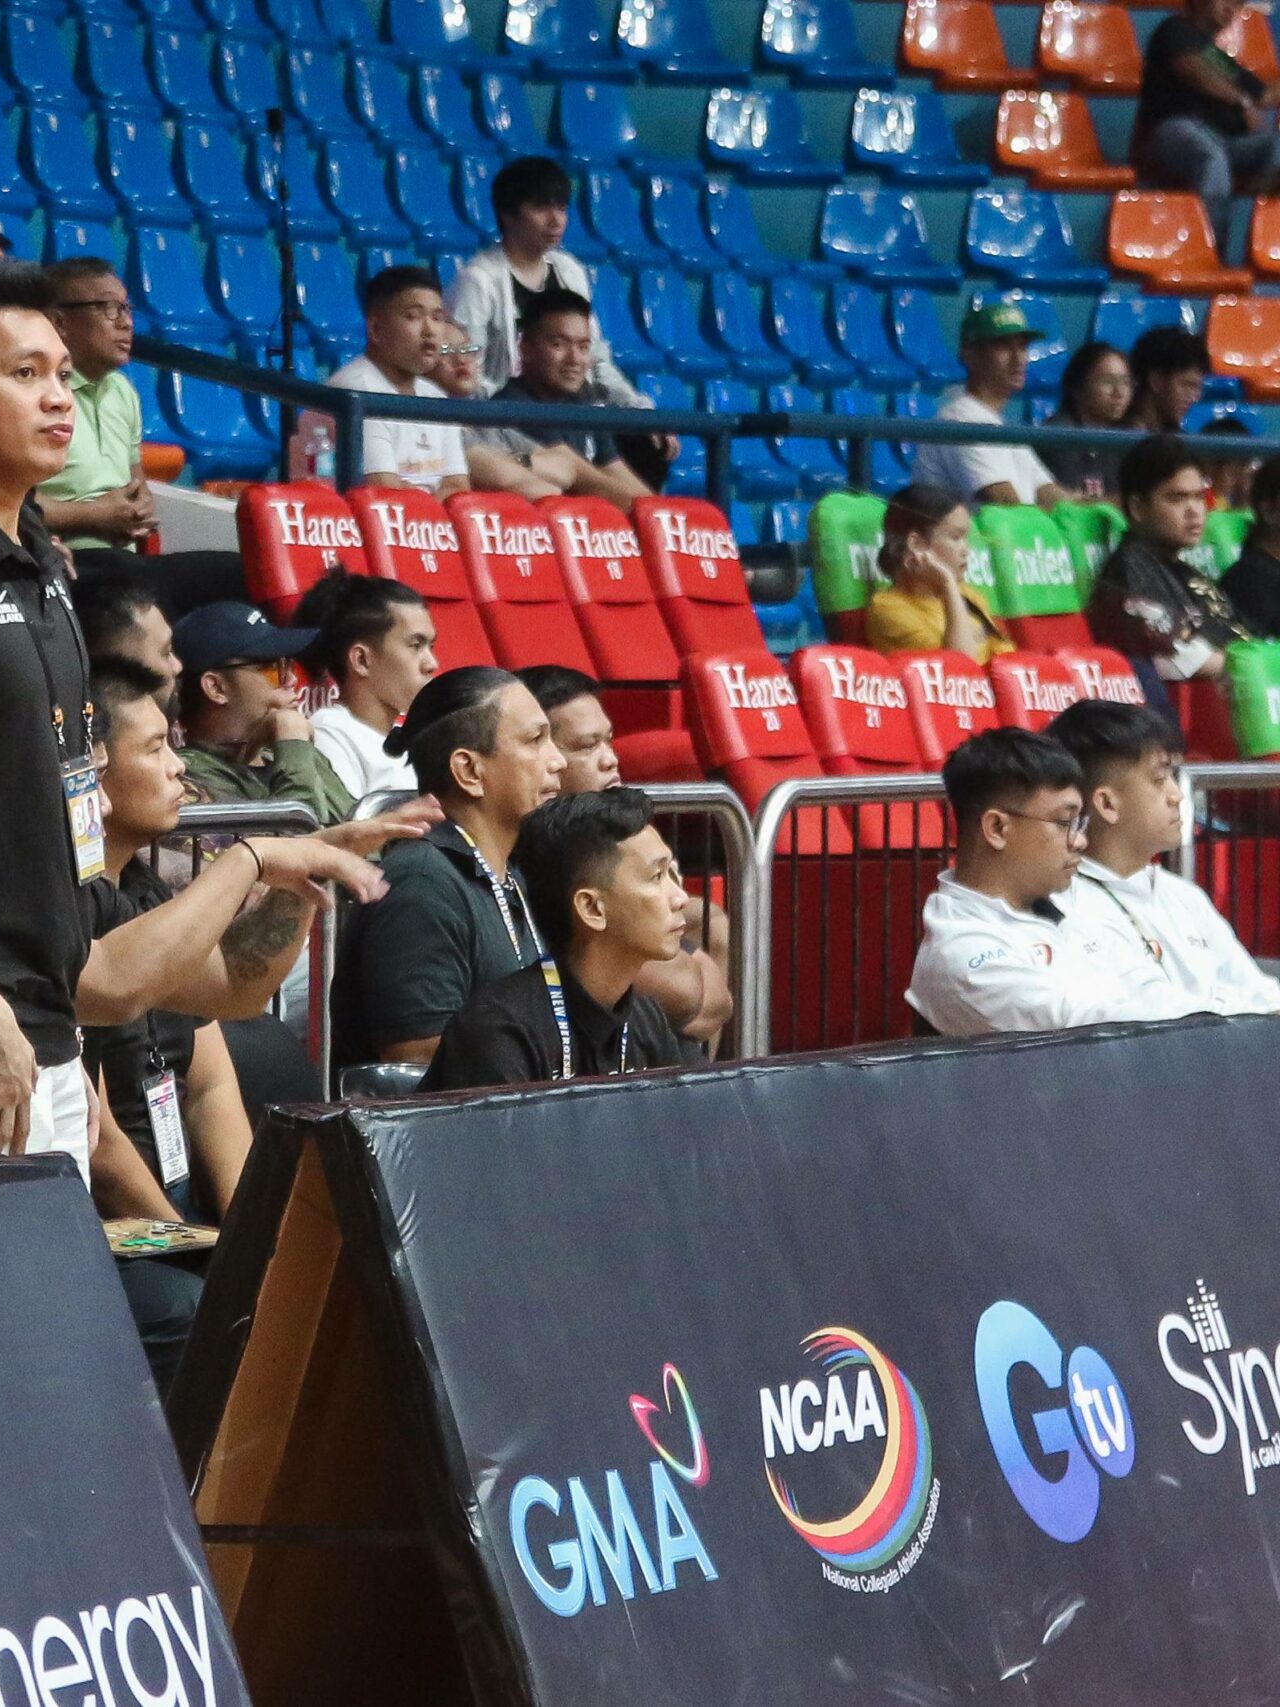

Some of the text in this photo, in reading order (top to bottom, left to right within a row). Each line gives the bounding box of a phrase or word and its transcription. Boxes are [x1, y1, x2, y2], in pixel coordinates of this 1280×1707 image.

[269, 501, 363, 549] Hanes
[369, 502, 459, 553] Hanes
[470, 512, 556, 556] Hanes
[558, 515, 641, 560] Hanes
[653, 511, 740, 561] Hanes
[422, 553, 439, 573] 16
[515, 557, 533, 577] 17
[699, 558, 718, 579] 19
[297, 685, 340, 719] ane
[715, 663, 798, 709] Hanes
[818, 657, 909, 710] Hanes
[910, 660, 996, 709] Hanes
[550, 991, 566, 1017] NEW
[558, 1021, 571, 1069] HEROES
[759, 1370, 886, 1458] NCAA
[508, 1460, 719, 1618] GMA
[822, 1478, 941, 1593] National Collegiate Athletic Association
